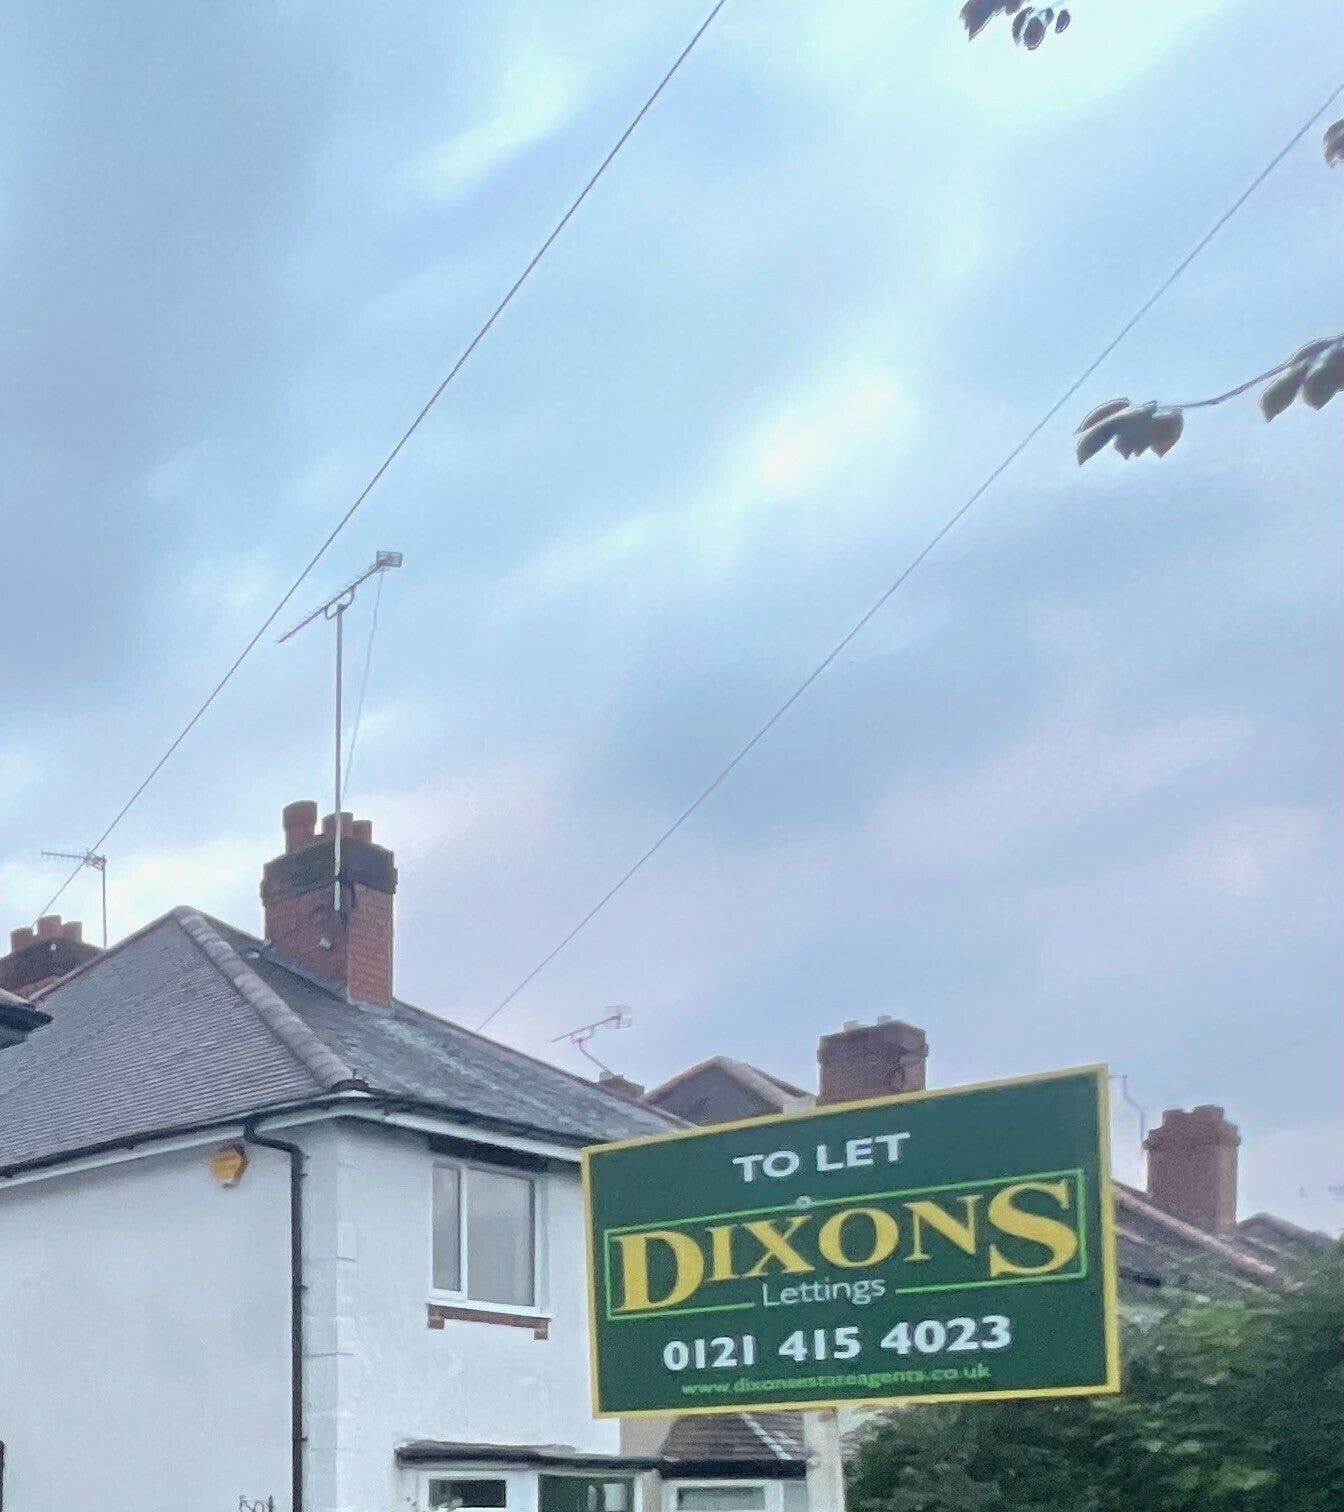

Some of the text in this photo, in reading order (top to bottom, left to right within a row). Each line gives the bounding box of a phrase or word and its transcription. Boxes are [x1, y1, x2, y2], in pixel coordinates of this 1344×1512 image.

[733, 1132, 911, 1182] TO LET
[613, 1181, 1078, 1312] DIXONS
[762, 1276, 886, 1308] Lettings
[663, 1315, 1011, 1371] 0121 415 4023
